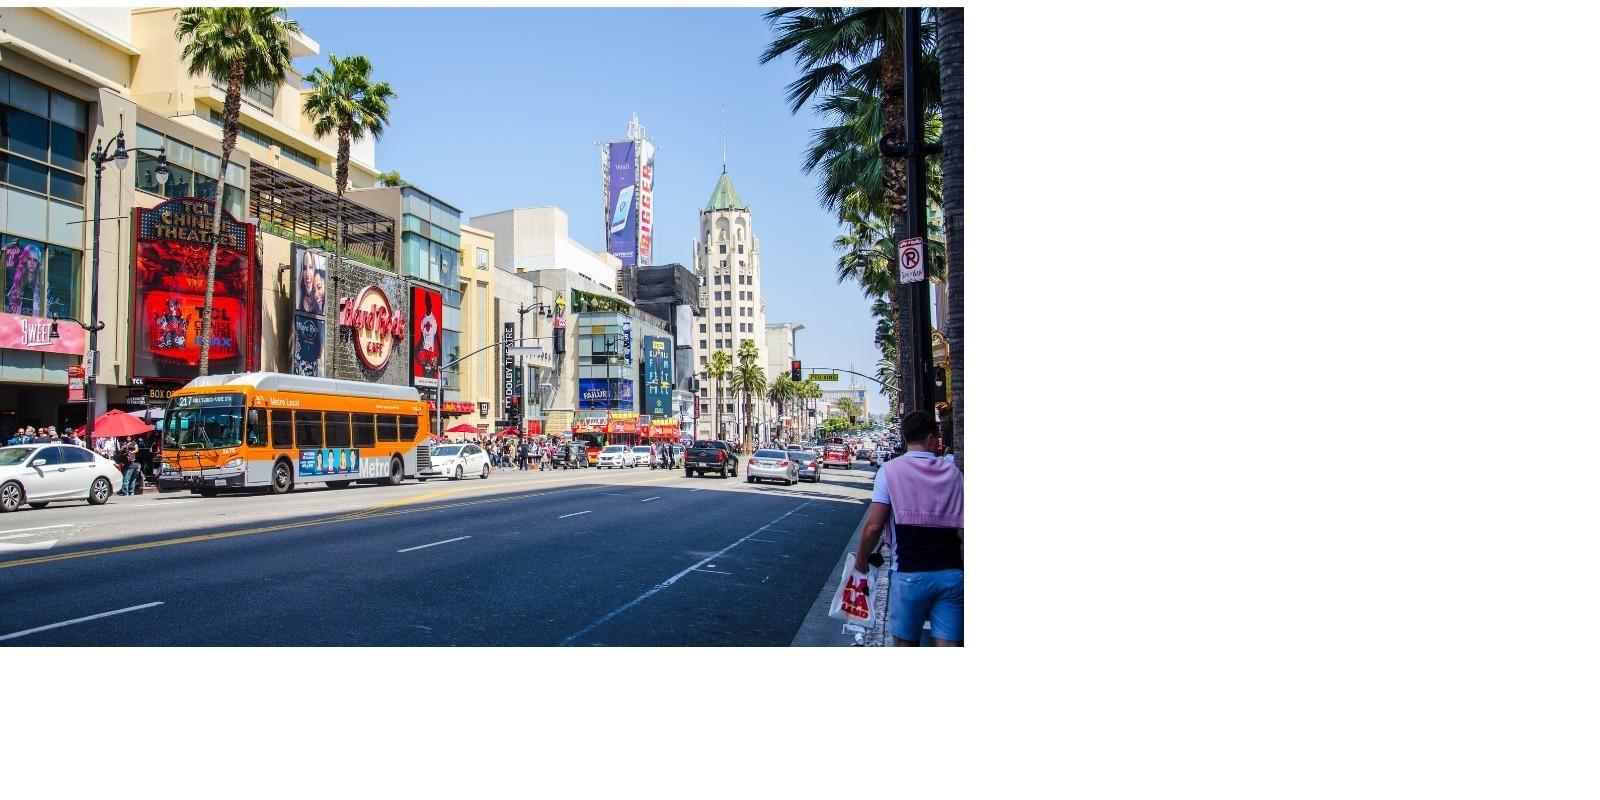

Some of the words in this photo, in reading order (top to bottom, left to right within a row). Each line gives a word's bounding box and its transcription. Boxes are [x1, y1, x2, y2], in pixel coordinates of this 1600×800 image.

[183, 201, 208, 215] TCL
[161, 211, 230, 233] CHINEE
[155, 225, 237, 246] THEATES
[505, 368, 513, 396] DOLBY
[150, 389, 165, 398] BOX
[179, 397, 192, 406] 217
[270, 398, 286, 406] Metro
[287, 399, 300, 407] Local
[360, 458, 390, 477] Metro
